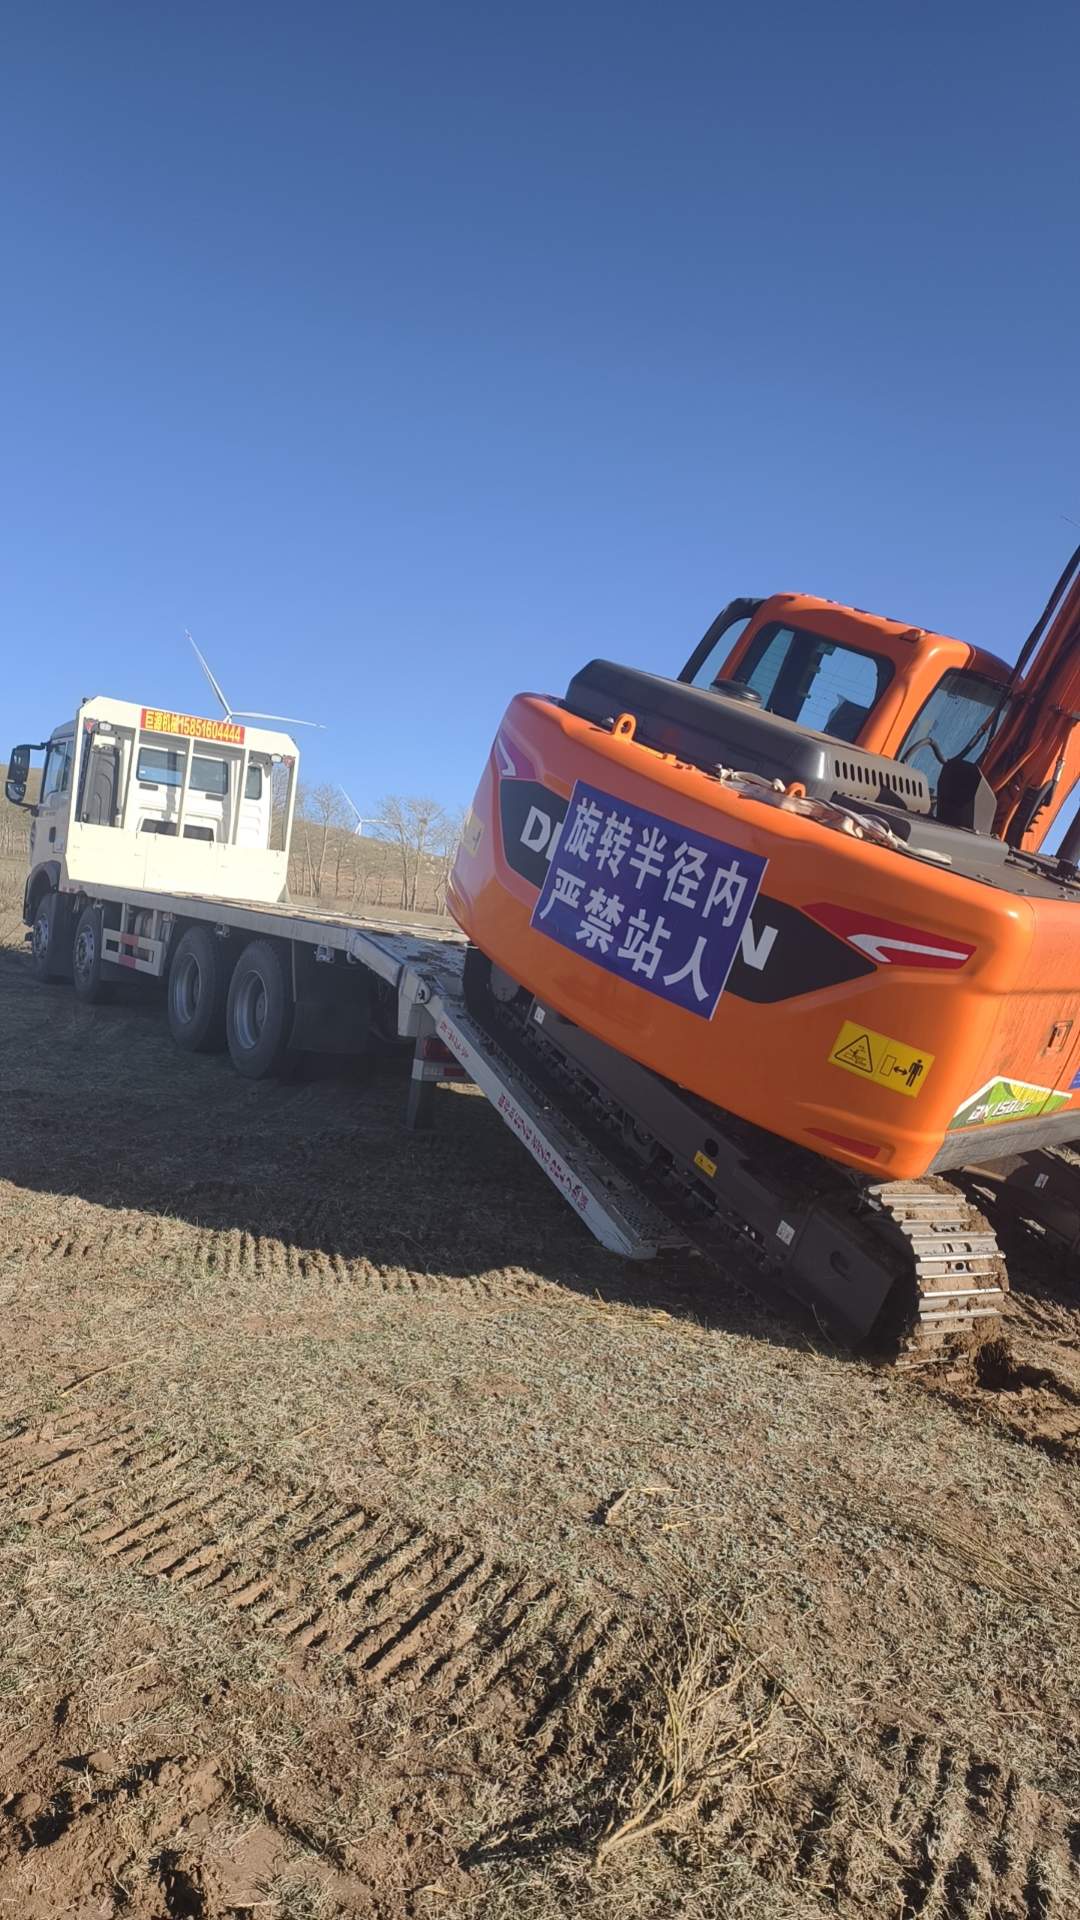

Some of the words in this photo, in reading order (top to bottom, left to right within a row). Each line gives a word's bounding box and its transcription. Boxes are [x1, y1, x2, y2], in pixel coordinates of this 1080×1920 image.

[564, 797, 748, 928] 旋转半径内
[539, 868, 709, 1002] 严禁站人
